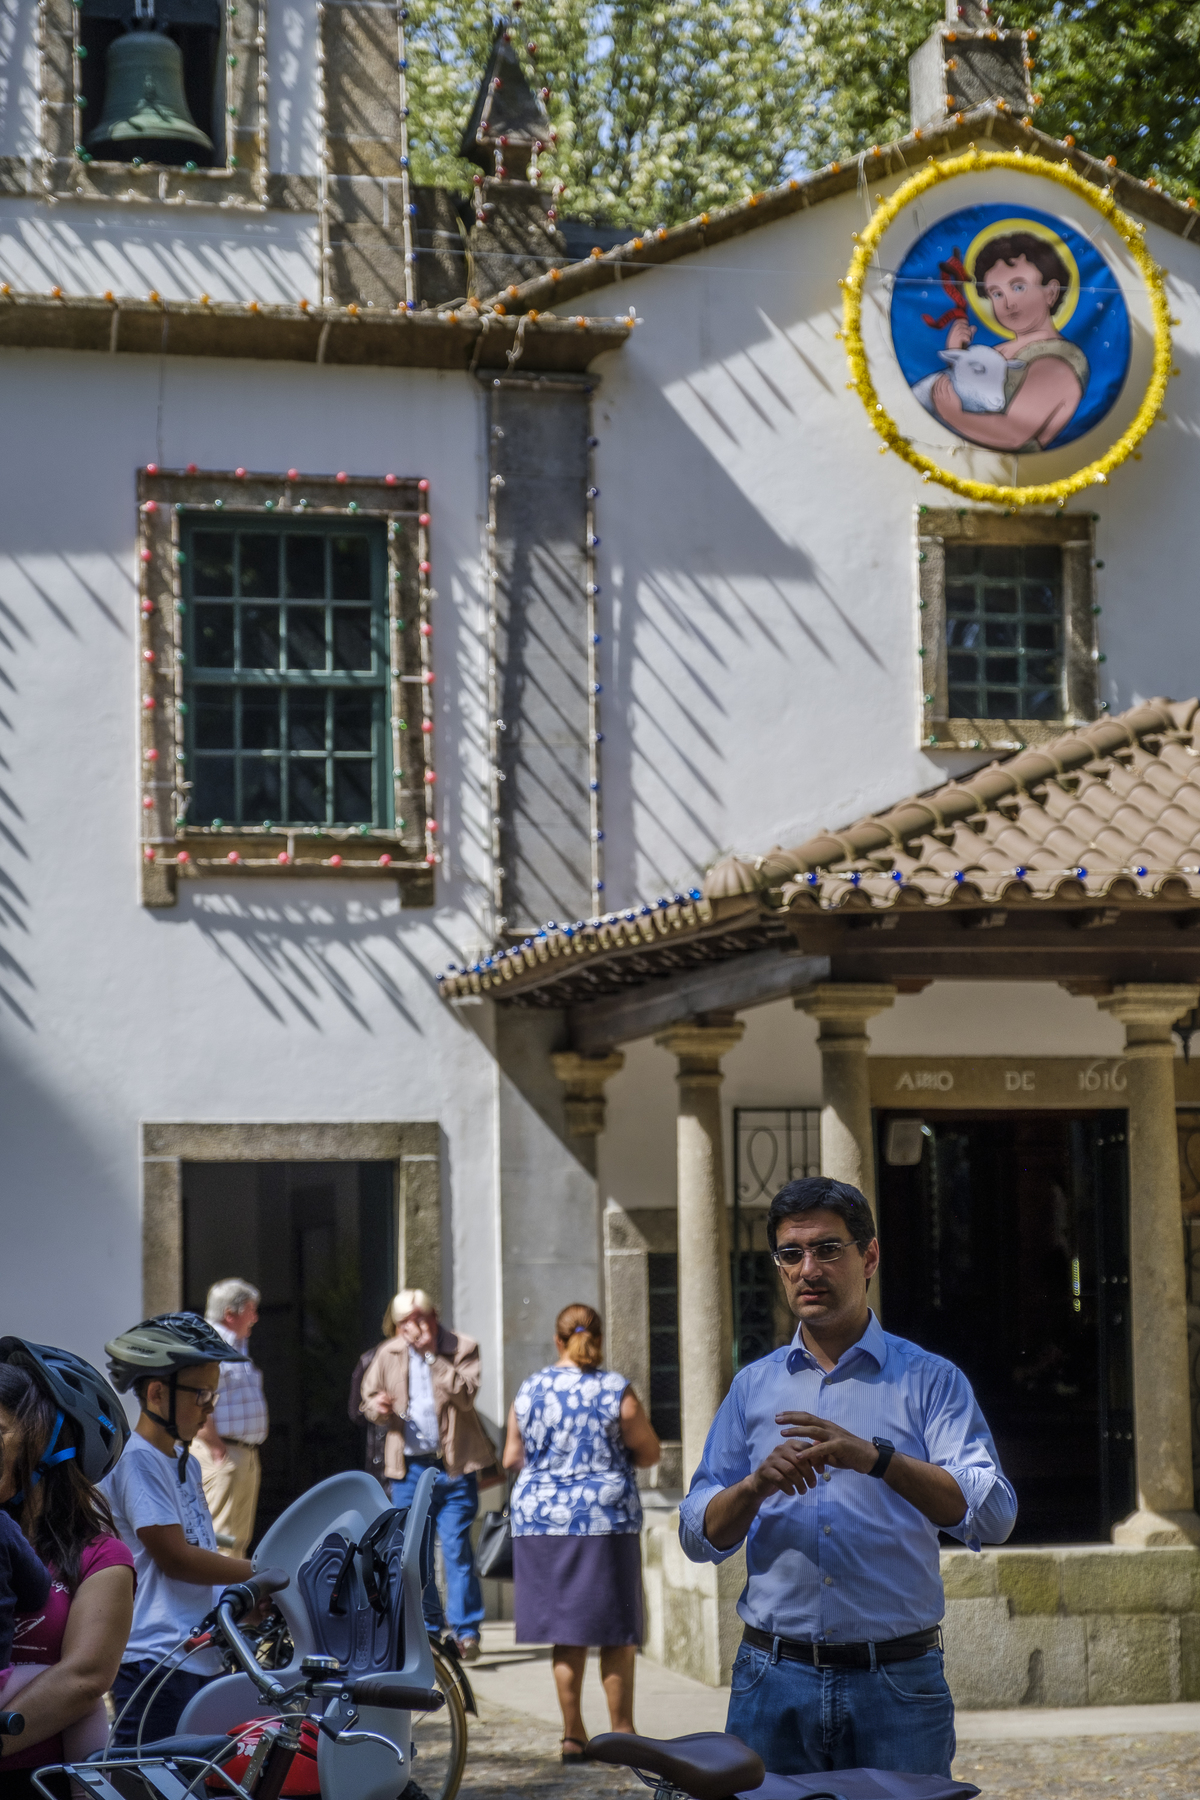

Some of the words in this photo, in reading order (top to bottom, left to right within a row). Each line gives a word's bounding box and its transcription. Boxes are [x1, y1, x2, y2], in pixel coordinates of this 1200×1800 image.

[1005, 1070, 1036, 1091] DE
[1077, 1059, 1128, 1091] 1616
[97, 1414, 117, 1435] BELL
